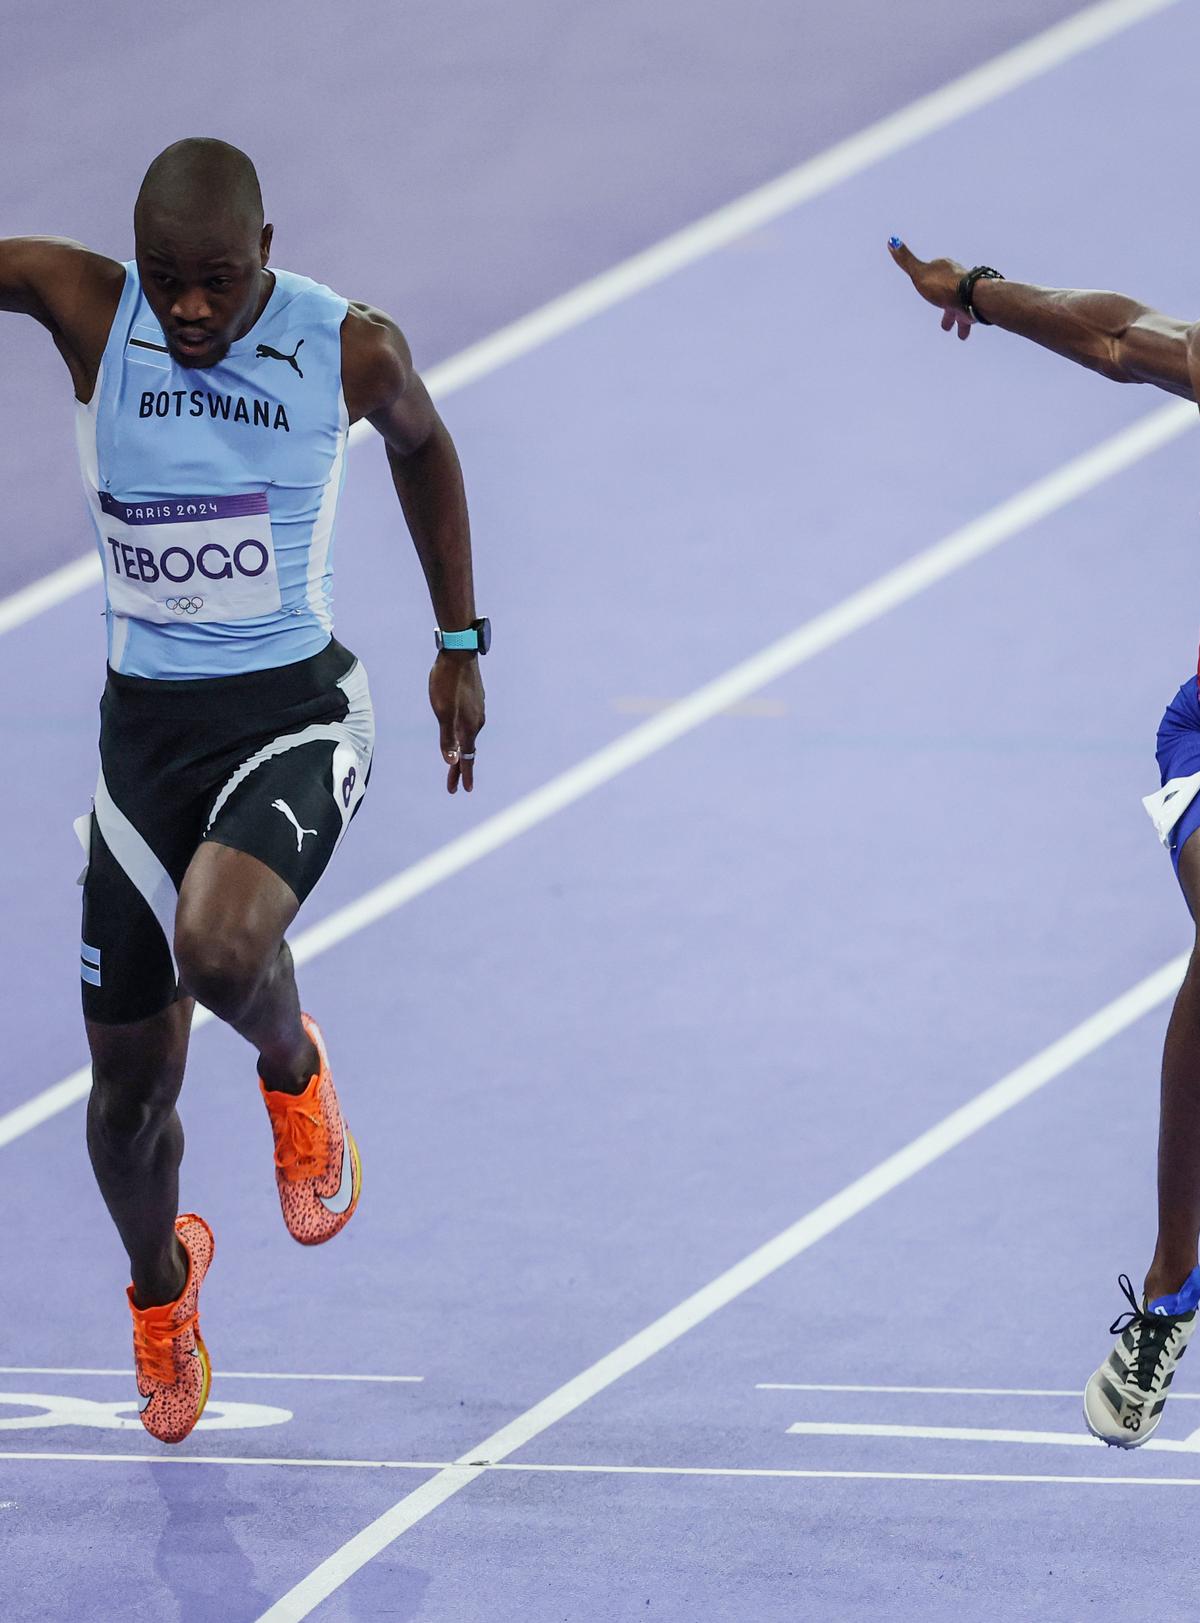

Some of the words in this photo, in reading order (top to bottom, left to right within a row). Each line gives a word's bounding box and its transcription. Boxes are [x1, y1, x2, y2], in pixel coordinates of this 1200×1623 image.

[138, 390, 290, 432] BOTSWANA
[126, 504, 171, 519] PARIS
[176, 503, 218, 516] 2024
[107, 536, 269, 583] TEBOGO
[342, 766, 356, 808] 8
